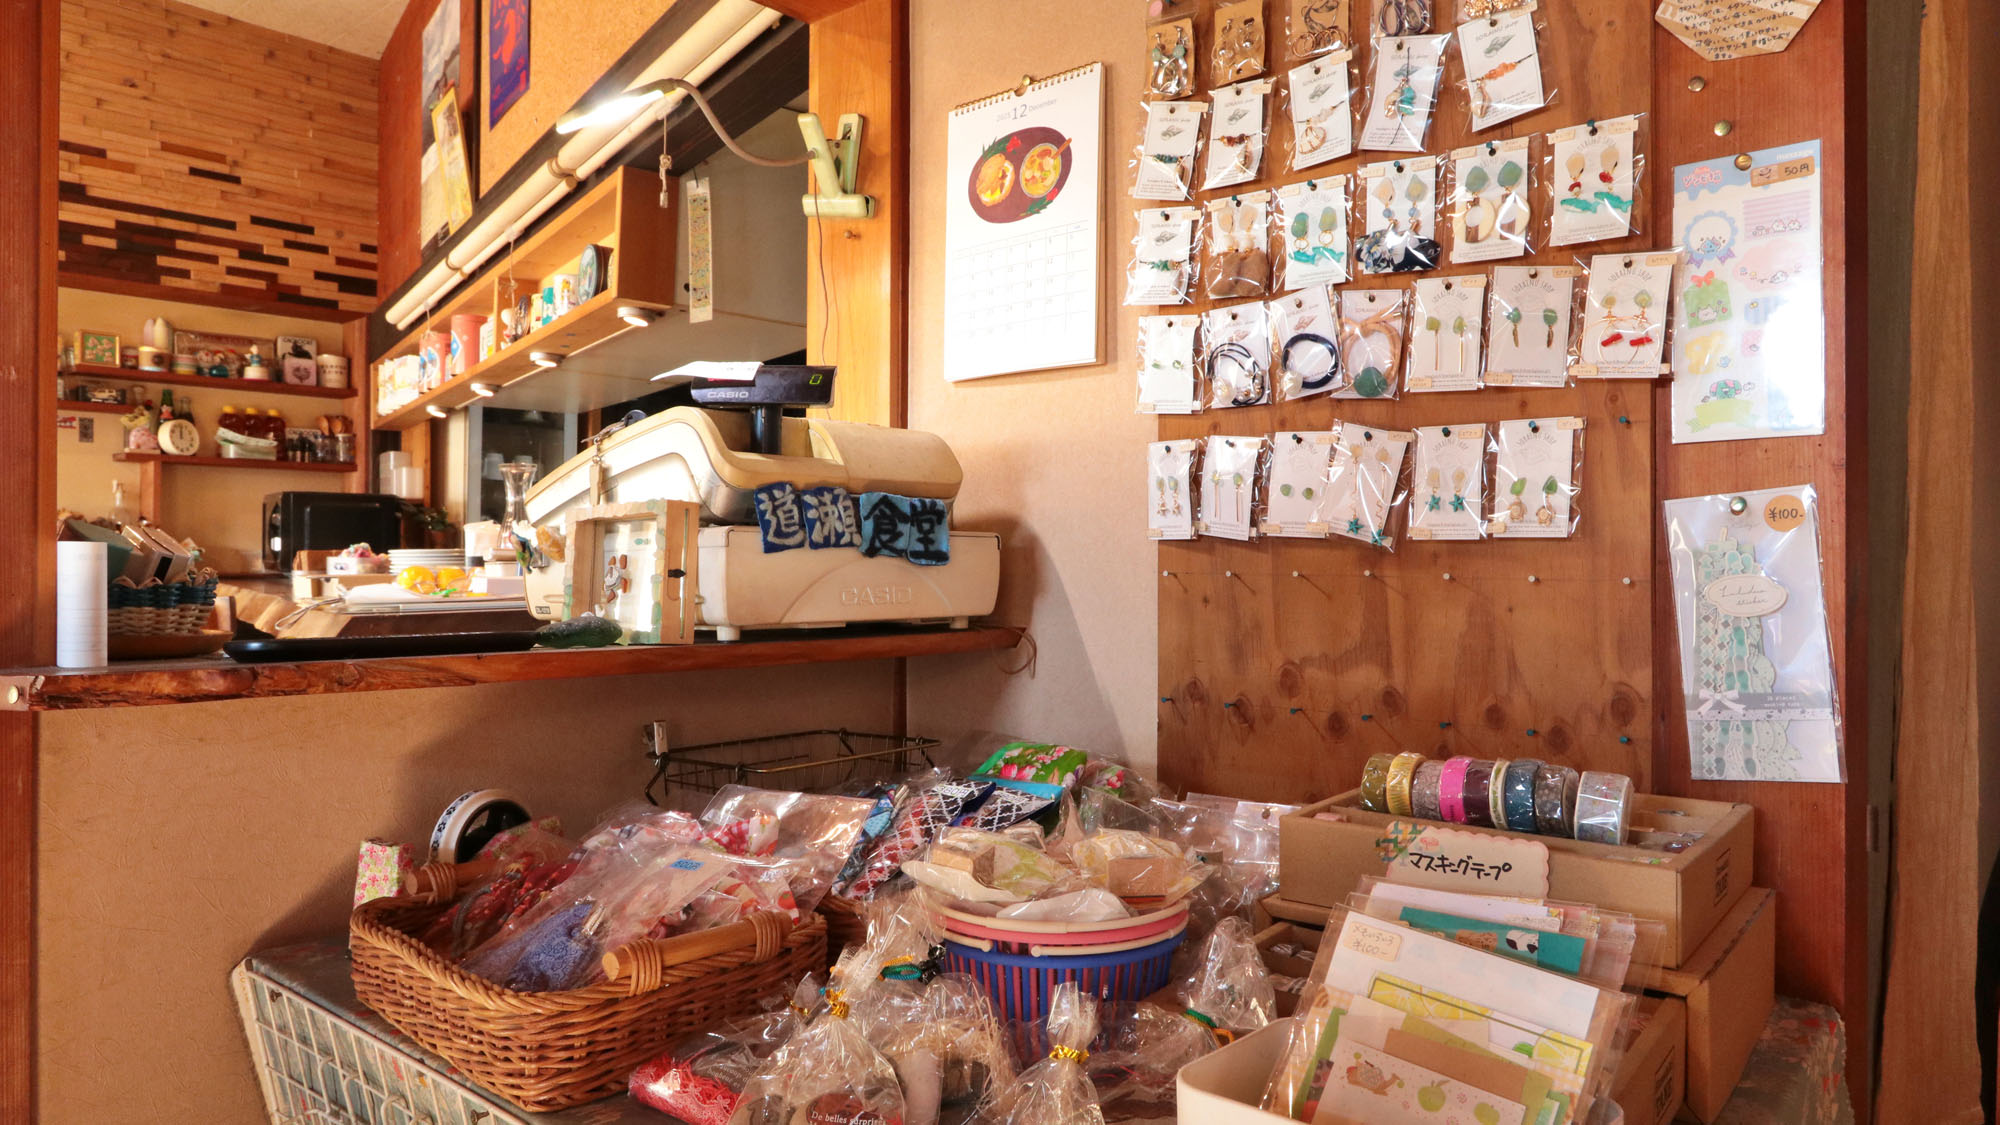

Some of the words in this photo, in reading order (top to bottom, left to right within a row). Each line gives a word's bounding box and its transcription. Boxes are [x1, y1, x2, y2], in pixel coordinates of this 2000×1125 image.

[1012, 104, 1028, 120] 12
[1028, 98, 1057, 113] December
[1784, 162, 1810, 177] 50円
[809, 374, 823, 385] 0
[706, 391, 749, 399] CASIO
[840, 583, 913, 607] CASIO
[1409, 852, 1513, 881] マスキングテープ
[811, 1111, 824, 1121] De
[825, 1113, 848, 1125] belles
